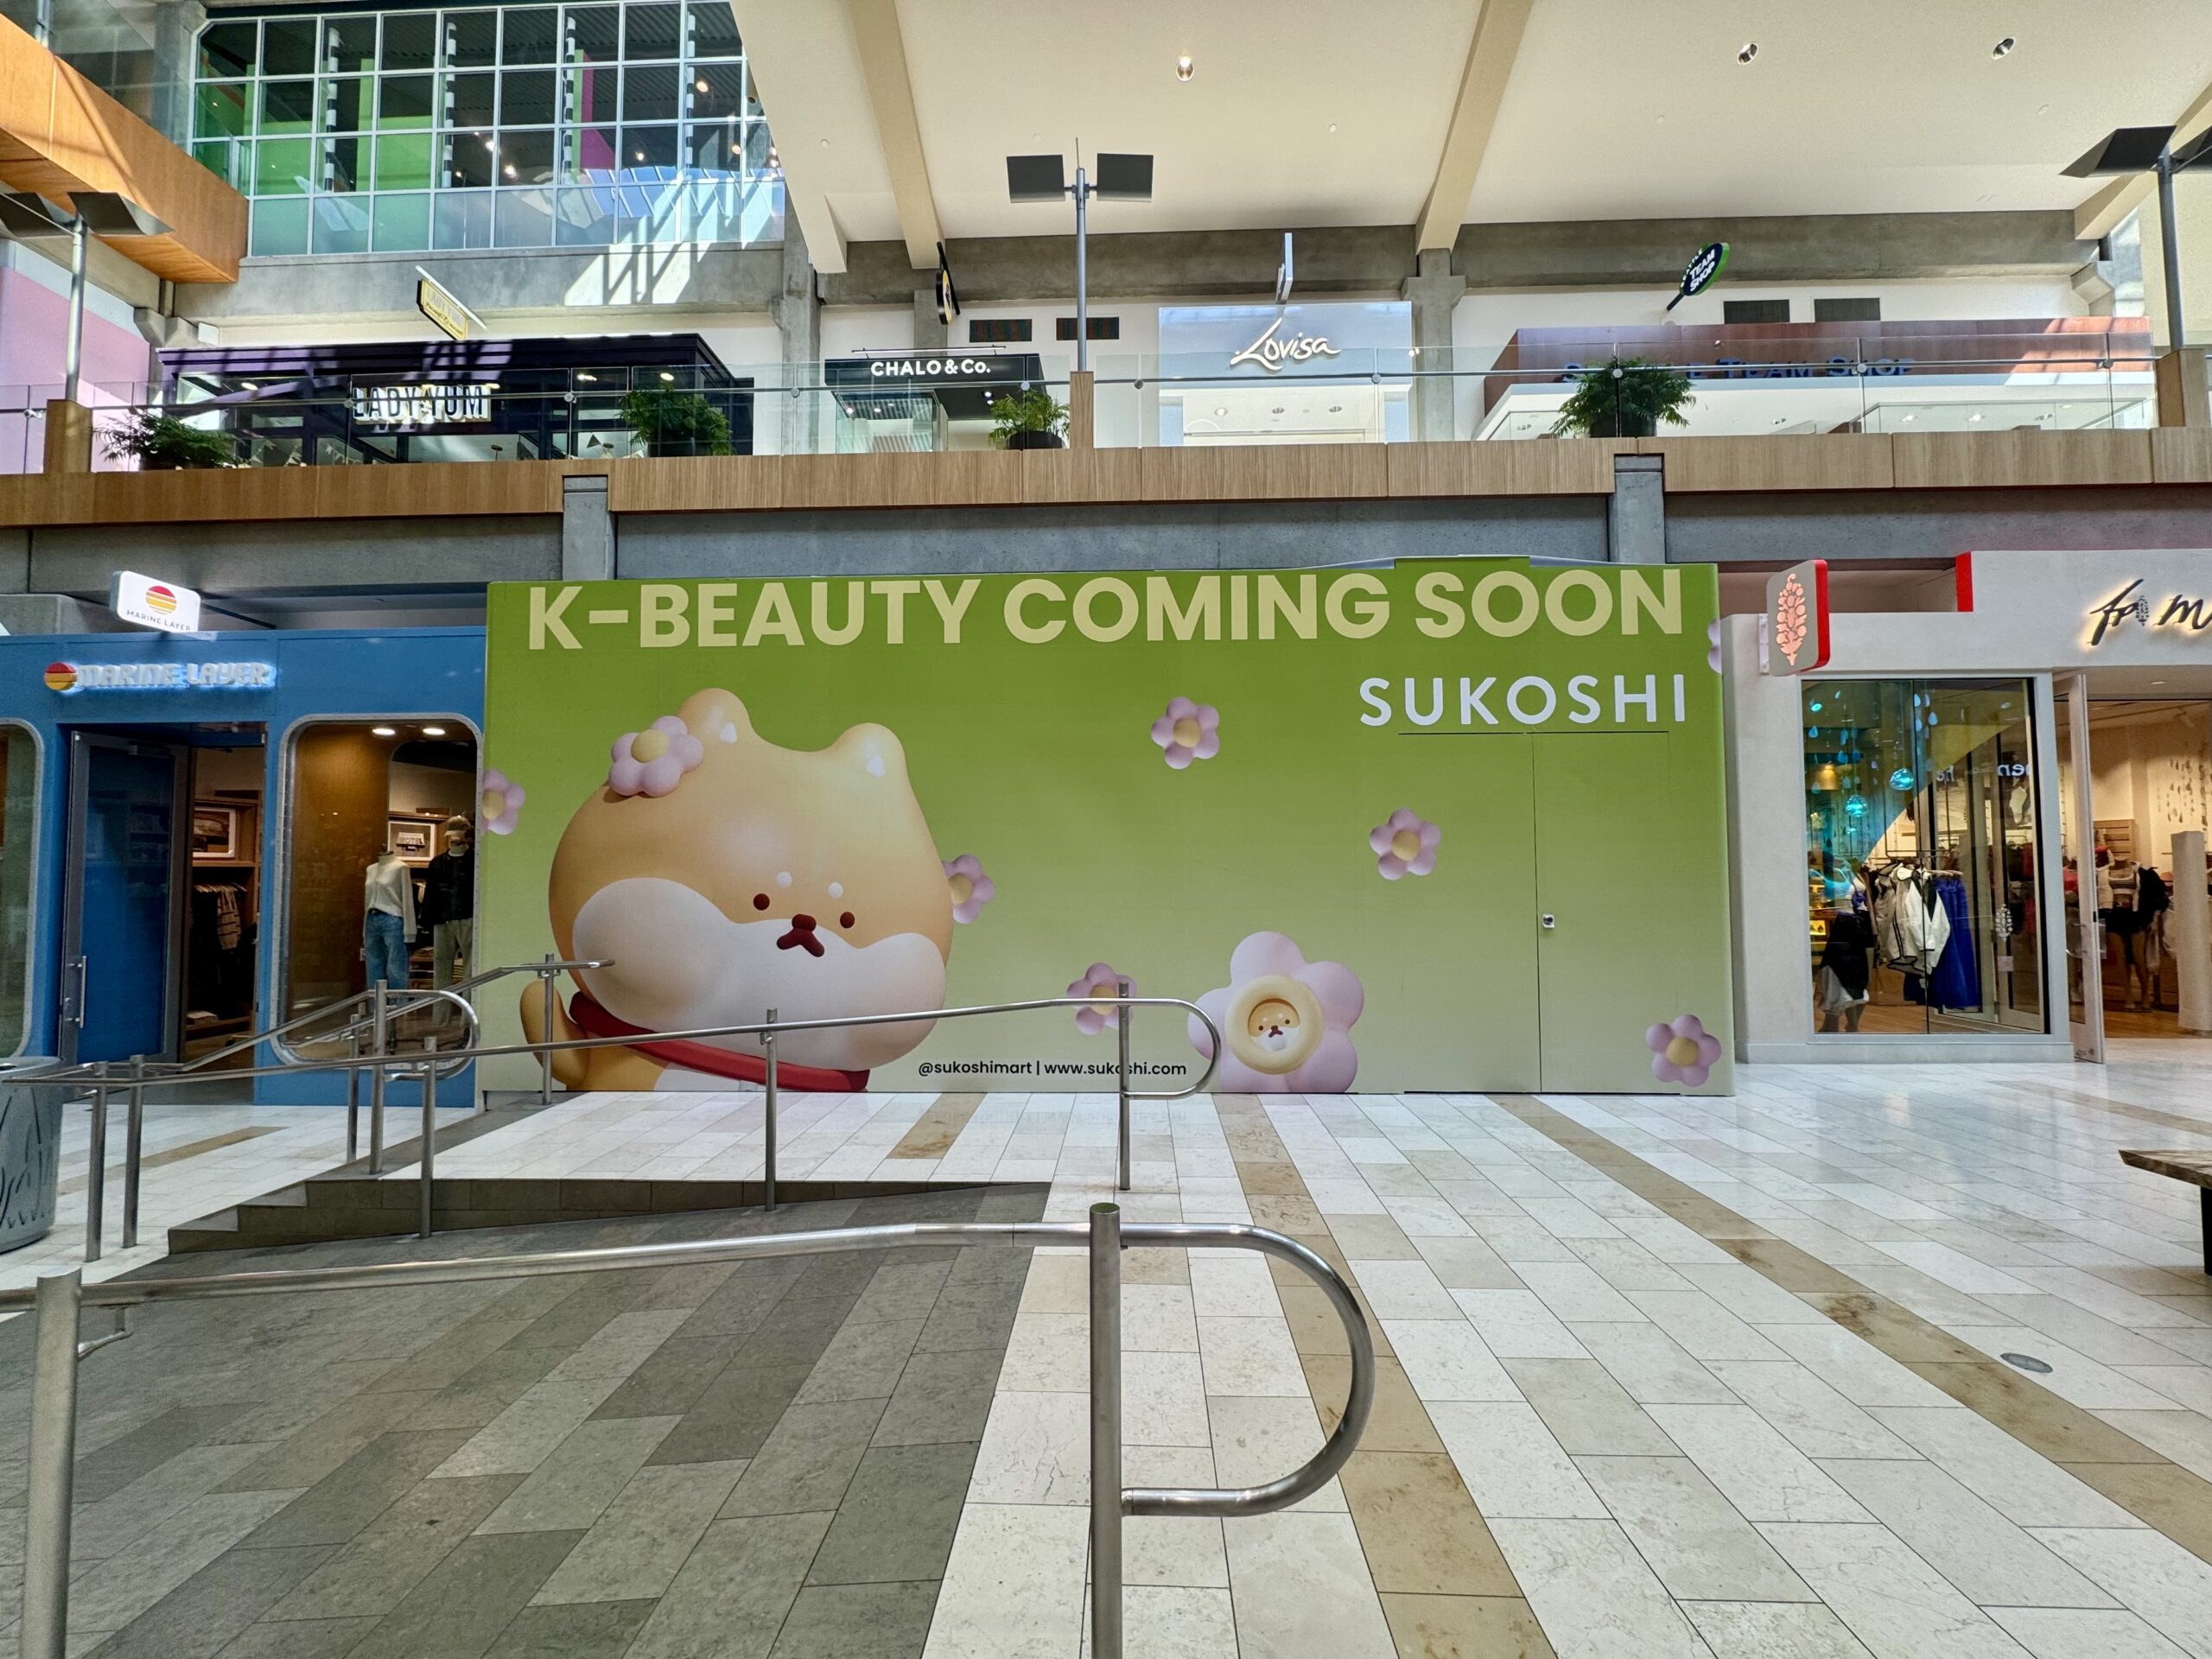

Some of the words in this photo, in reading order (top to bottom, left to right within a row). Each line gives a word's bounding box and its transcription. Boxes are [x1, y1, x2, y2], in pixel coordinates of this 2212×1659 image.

[1689, 248, 1716, 280] TEAM
[1689, 261, 1716, 292] SHOP
[1230, 317, 1342, 372] Lovisa
[870, 359, 942, 377] CHALO
[944, 359, 959, 375] &
[961, 359, 992, 374] Co.
[353, 386, 418, 420] LADY
[126, 609, 162, 625] MARINE
[164, 619, 192, 632] LAYER
[528, 578, 982, 651] K-BEAUTY
[1003, 572, 1390, 644] COMING
[1414, 569, 1683, 639] SOON
[78, 664, 180, 687] MARINE
[186, 662, 270, 685] LAYER
[1359, 674, 1686, 727] SUKOSHI
[918, 1060, 1033, 1077] @sukoshimart
